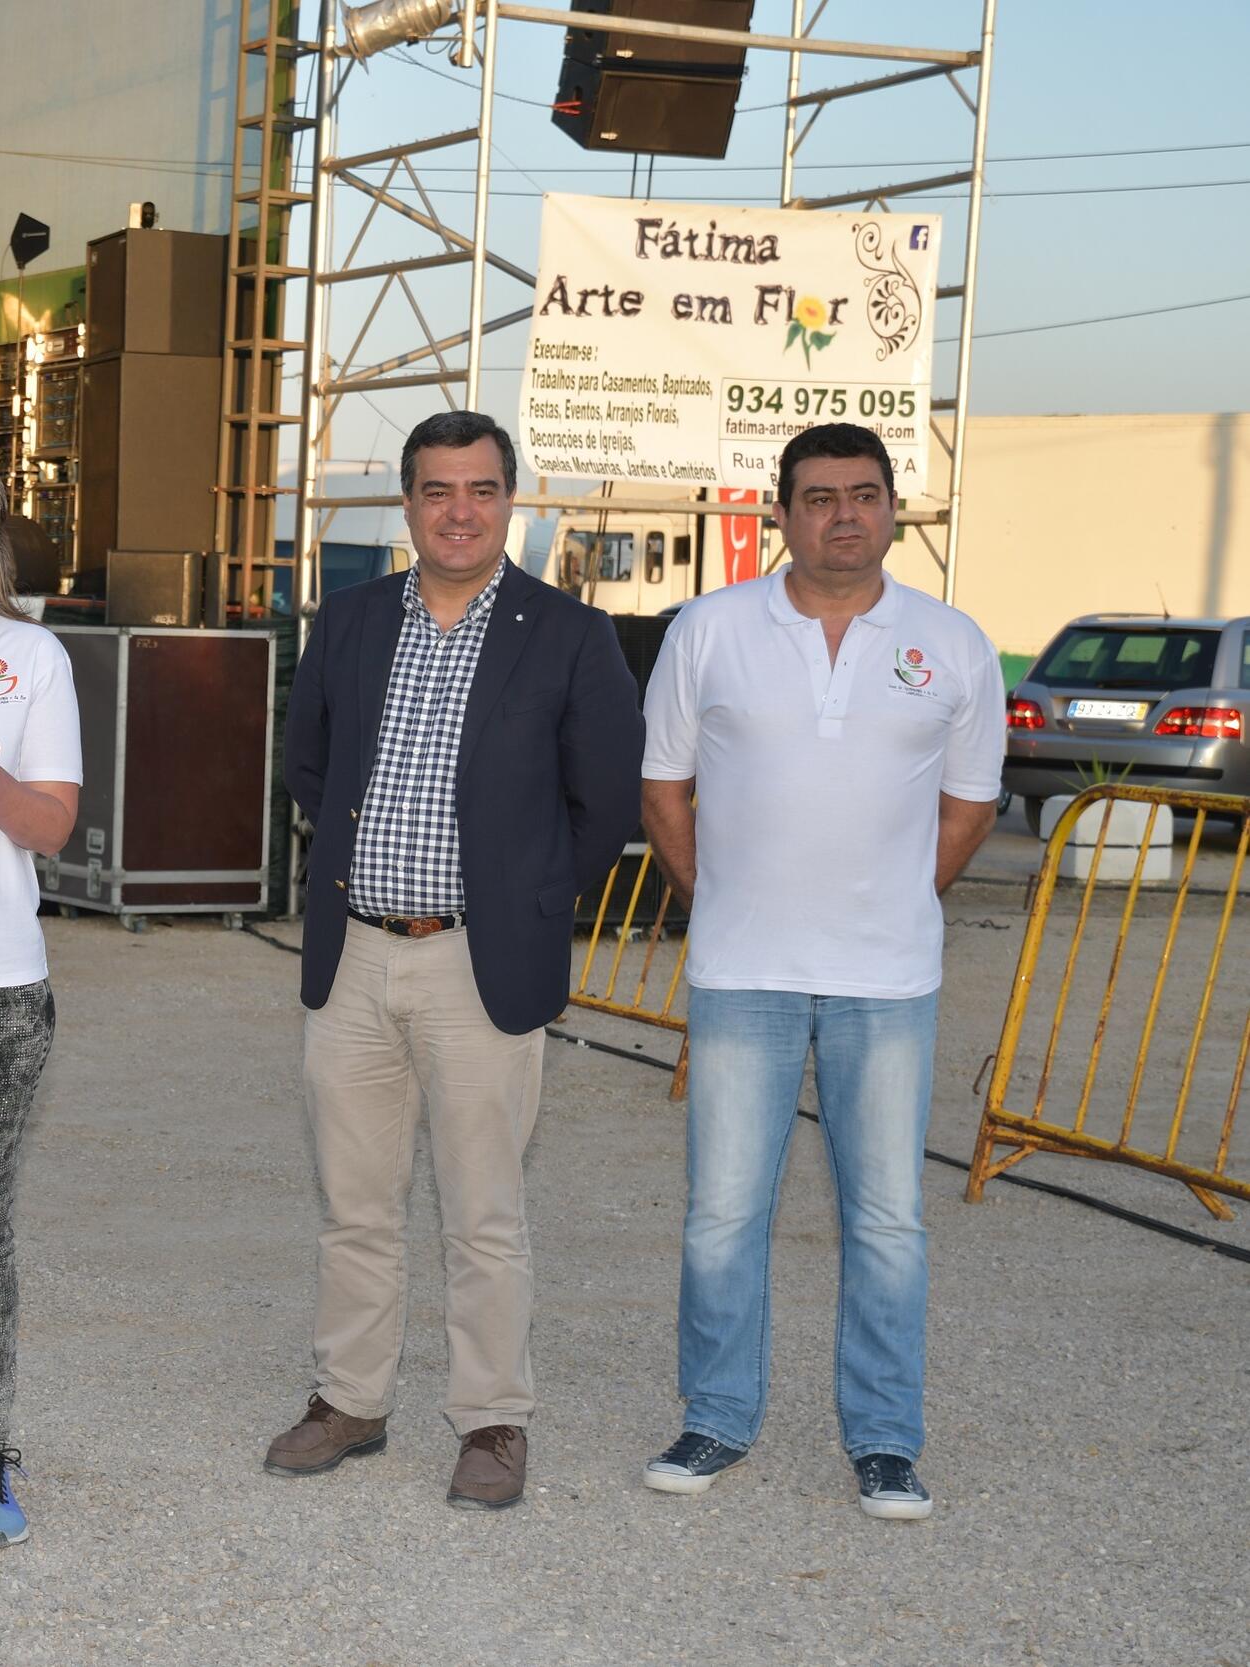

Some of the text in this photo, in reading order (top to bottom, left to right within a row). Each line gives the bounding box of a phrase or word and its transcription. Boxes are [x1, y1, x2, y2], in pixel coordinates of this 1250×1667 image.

[634, 217, 782, 265] Fátima
[538, 273, 645, 319] Arte
[670, 291, 734, 324] em
[531, 367, 713, 401] Trabalhos para Casamentos, Baptizados,
[529, 397, 680, 429] Festas, Eventos, Arranjos Florais,
[726, 384, 916, 418] 934 975 095
[585, 429, 598, 449] de
[534, 454, 573, 475] Capelas
[626, 459, 661, 479] Jardins
[661, 466, 668, 479] e
[732, 452, 765, 470] Rua
[903, 457, 918, 473] A
